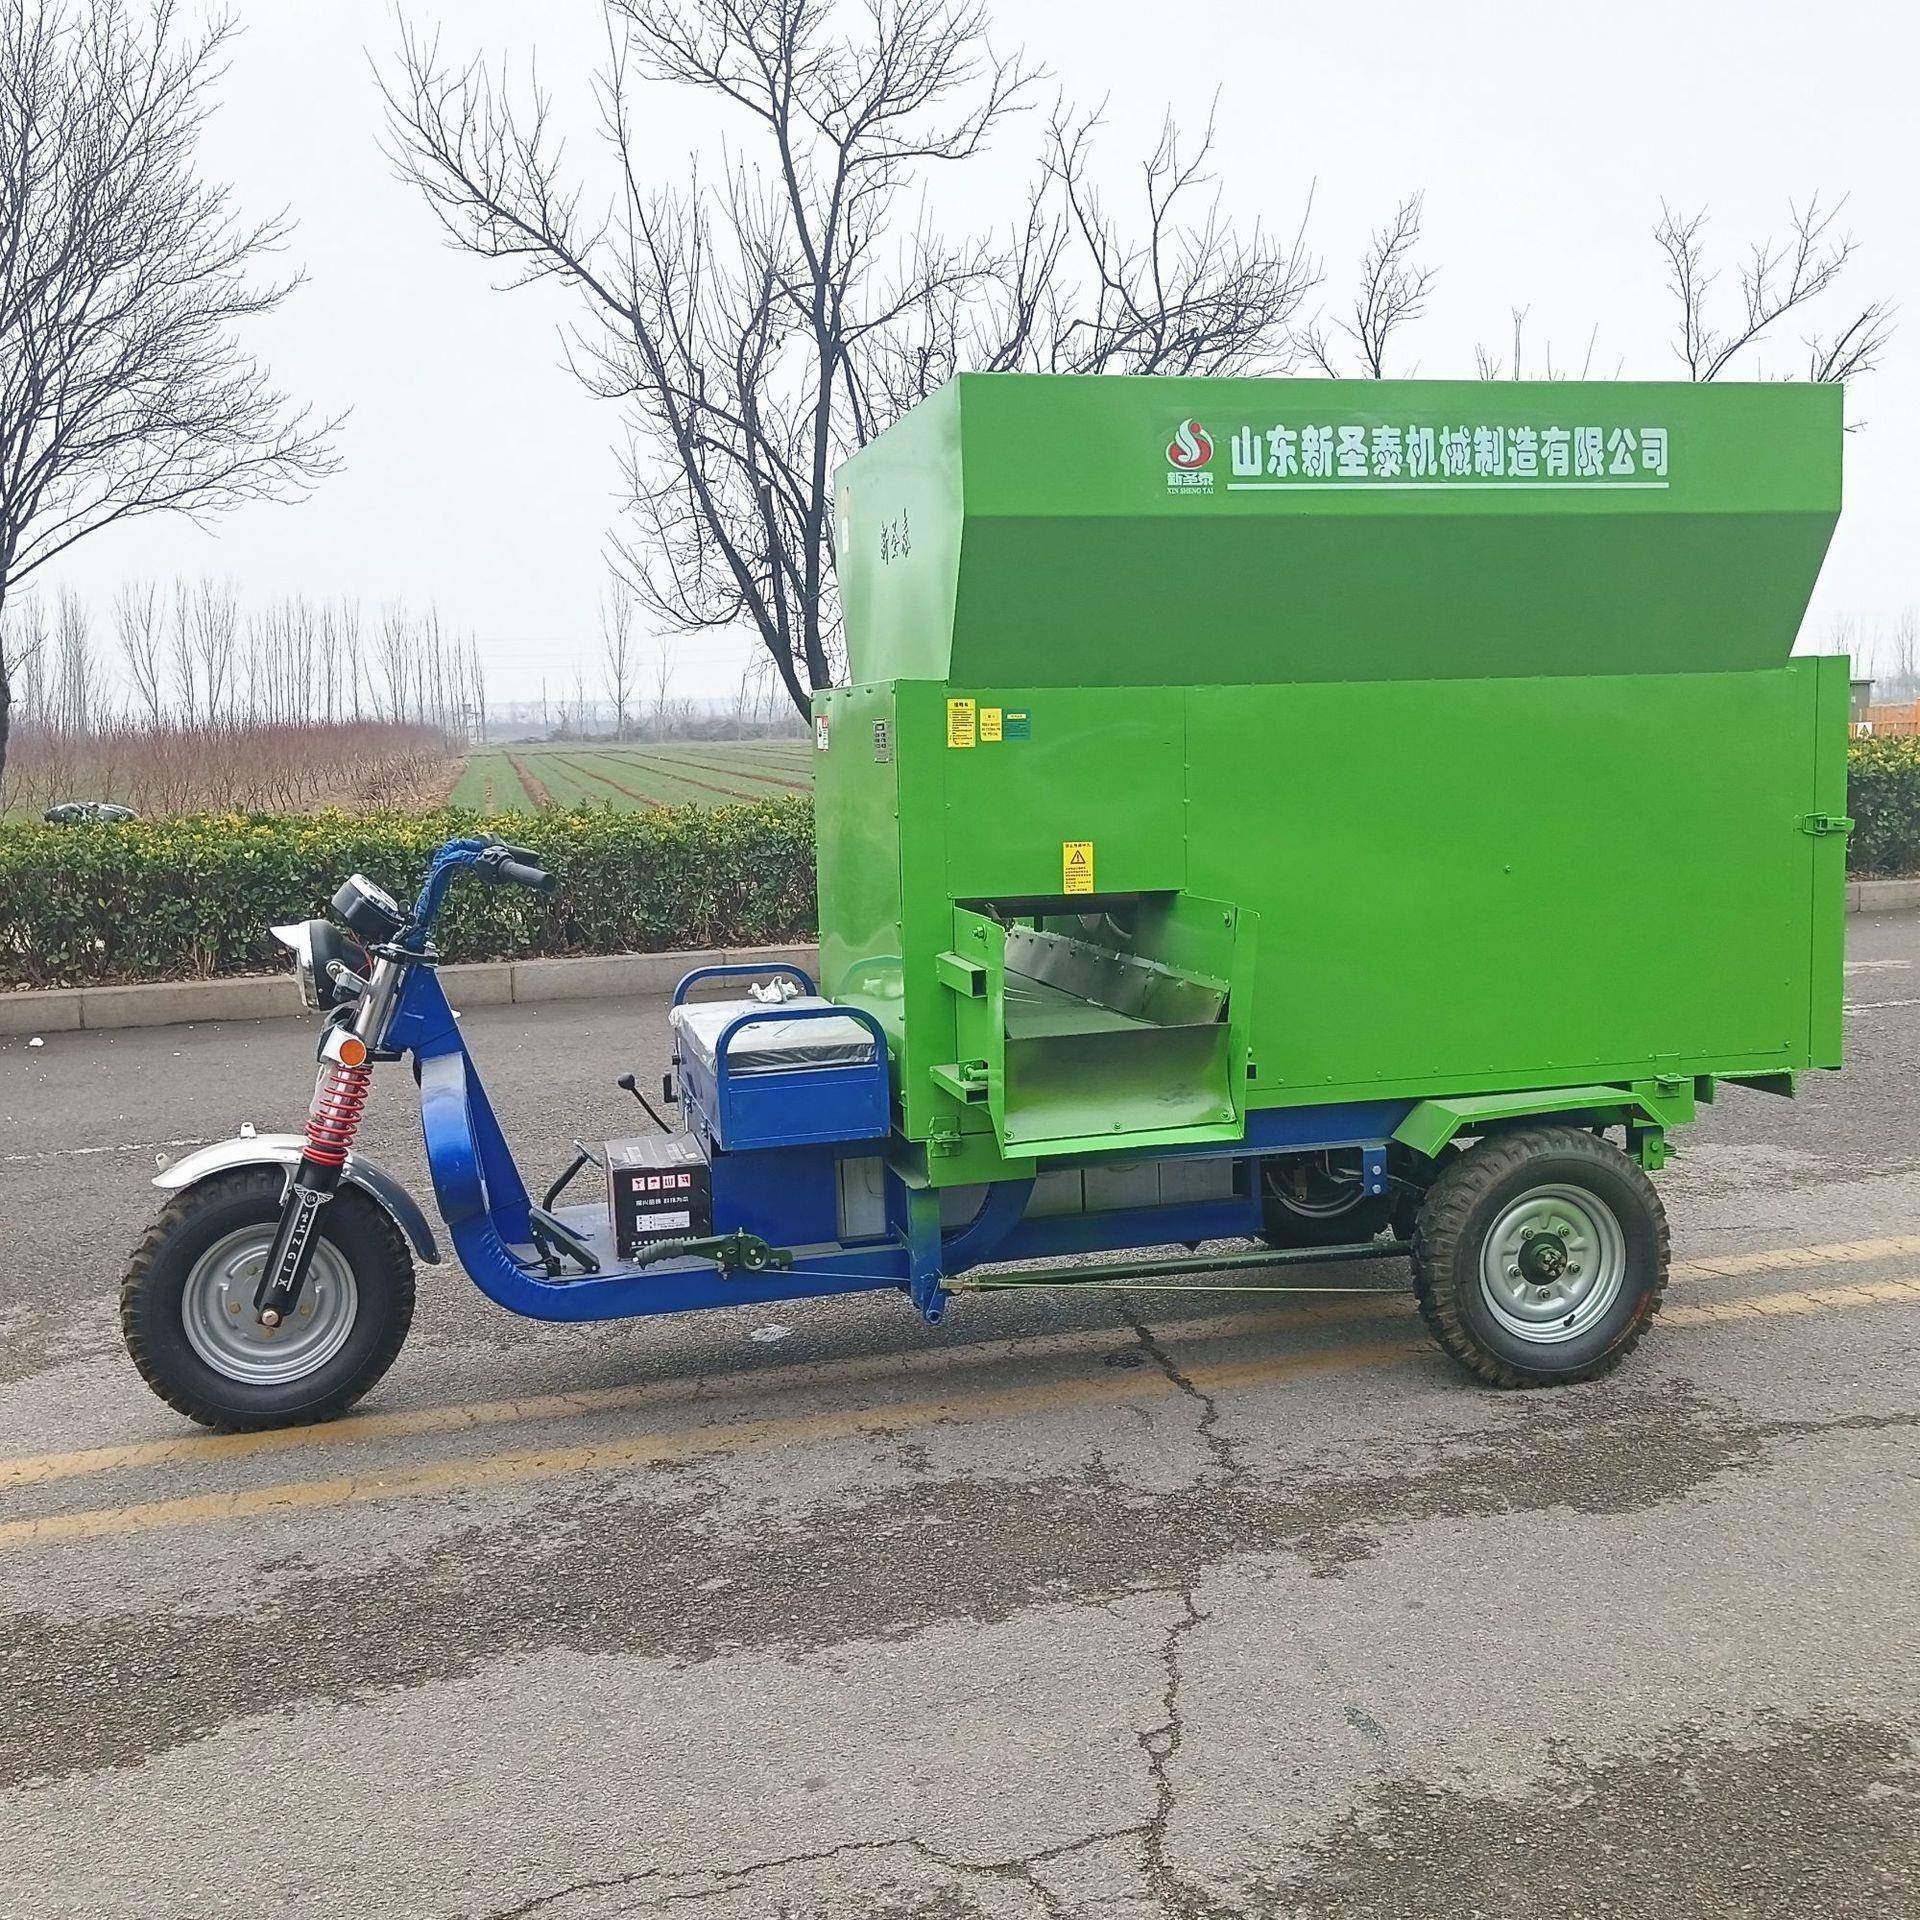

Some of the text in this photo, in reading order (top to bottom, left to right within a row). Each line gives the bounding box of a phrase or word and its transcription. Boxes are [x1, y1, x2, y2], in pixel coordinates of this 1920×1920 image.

[1231, 424, 1668, 477] 山东新圣泰机械制造有限公司
[1179, 487, 1202, 495] SHENG
